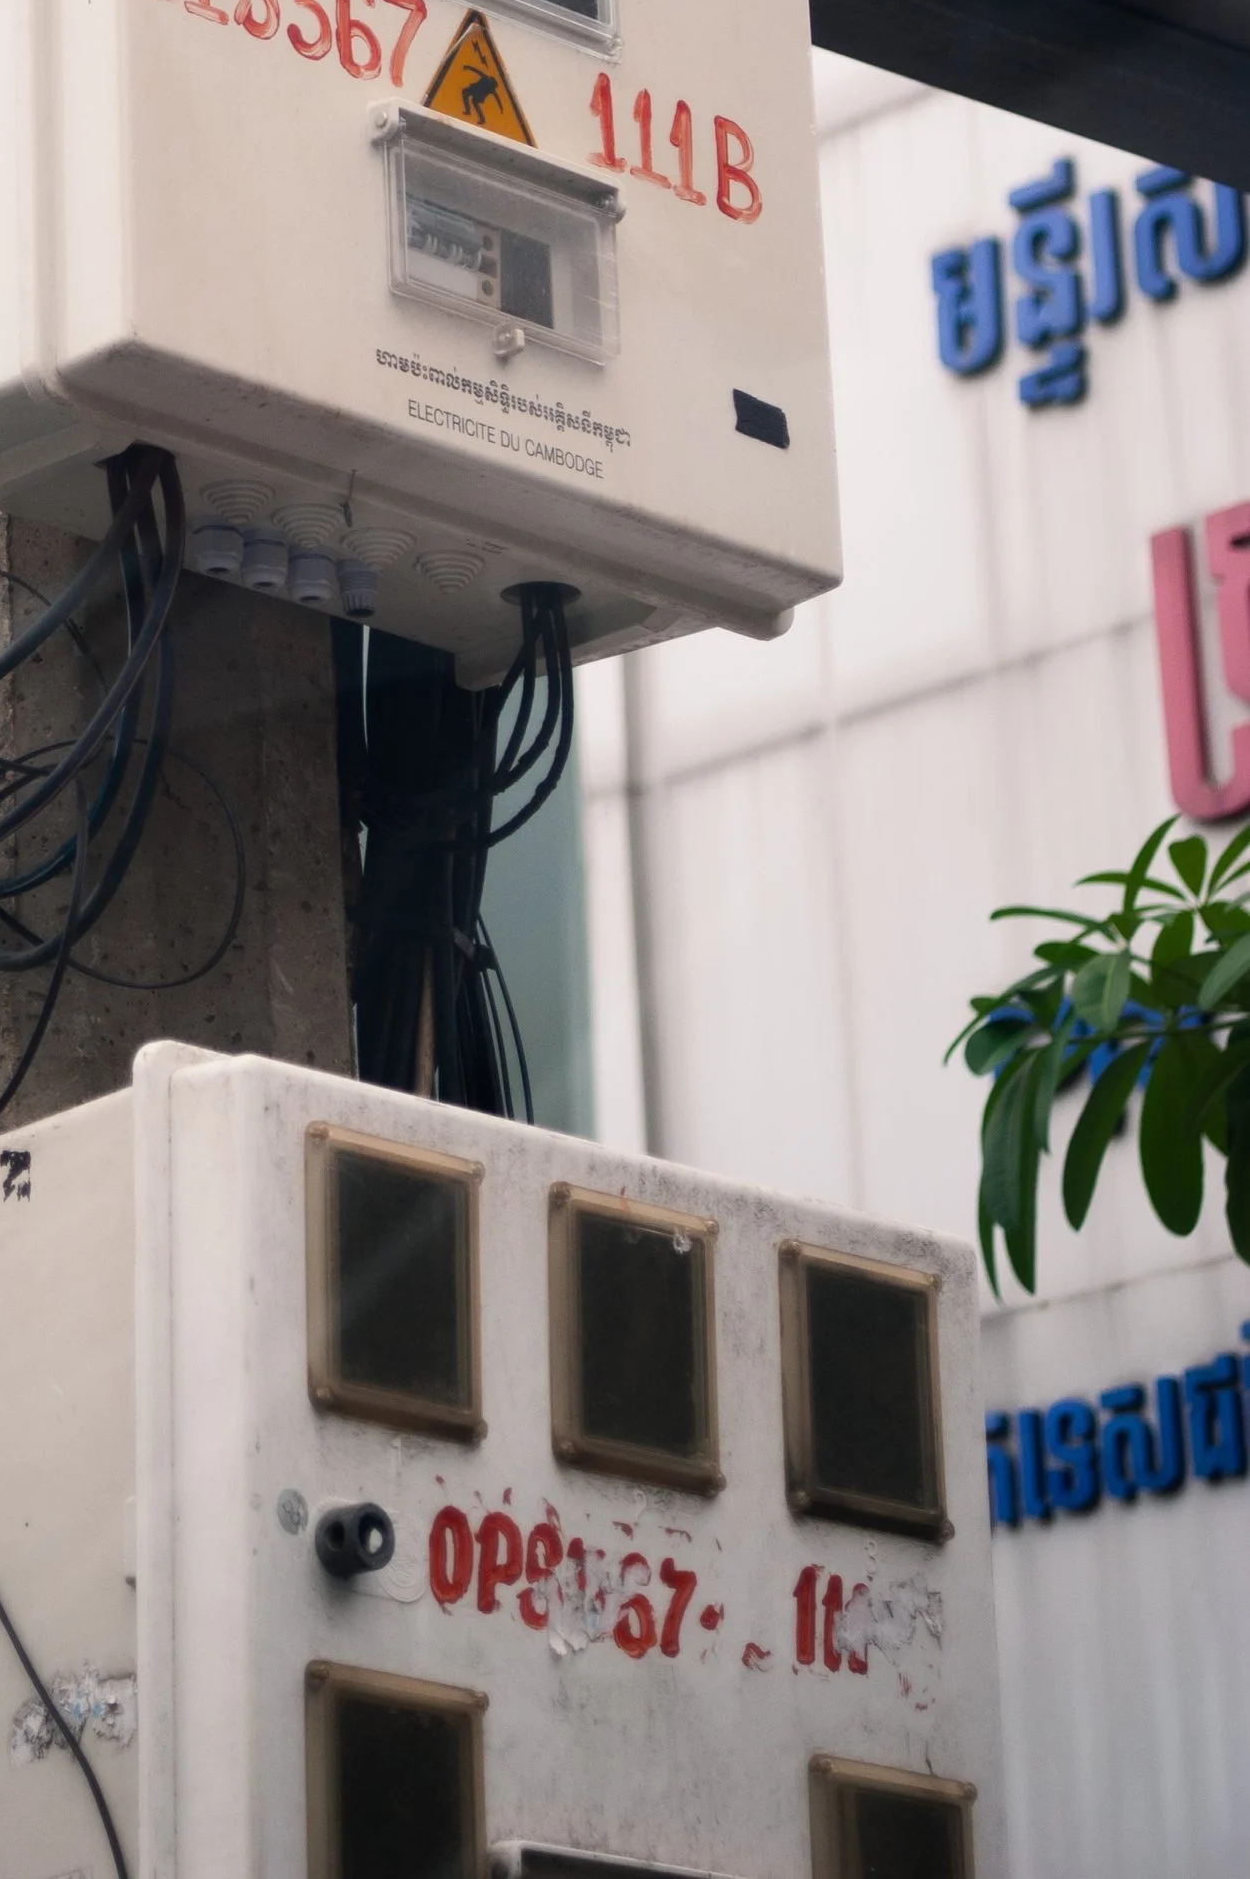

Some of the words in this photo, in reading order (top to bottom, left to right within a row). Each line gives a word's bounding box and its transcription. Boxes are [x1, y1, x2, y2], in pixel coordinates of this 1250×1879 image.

[588, 72, 763, 224] 111B
[408, 398, 496, 444] ELECTRICITE
[500, 430, 520, 452] DU
[525, 438, 604, 479] CAMBODGE
